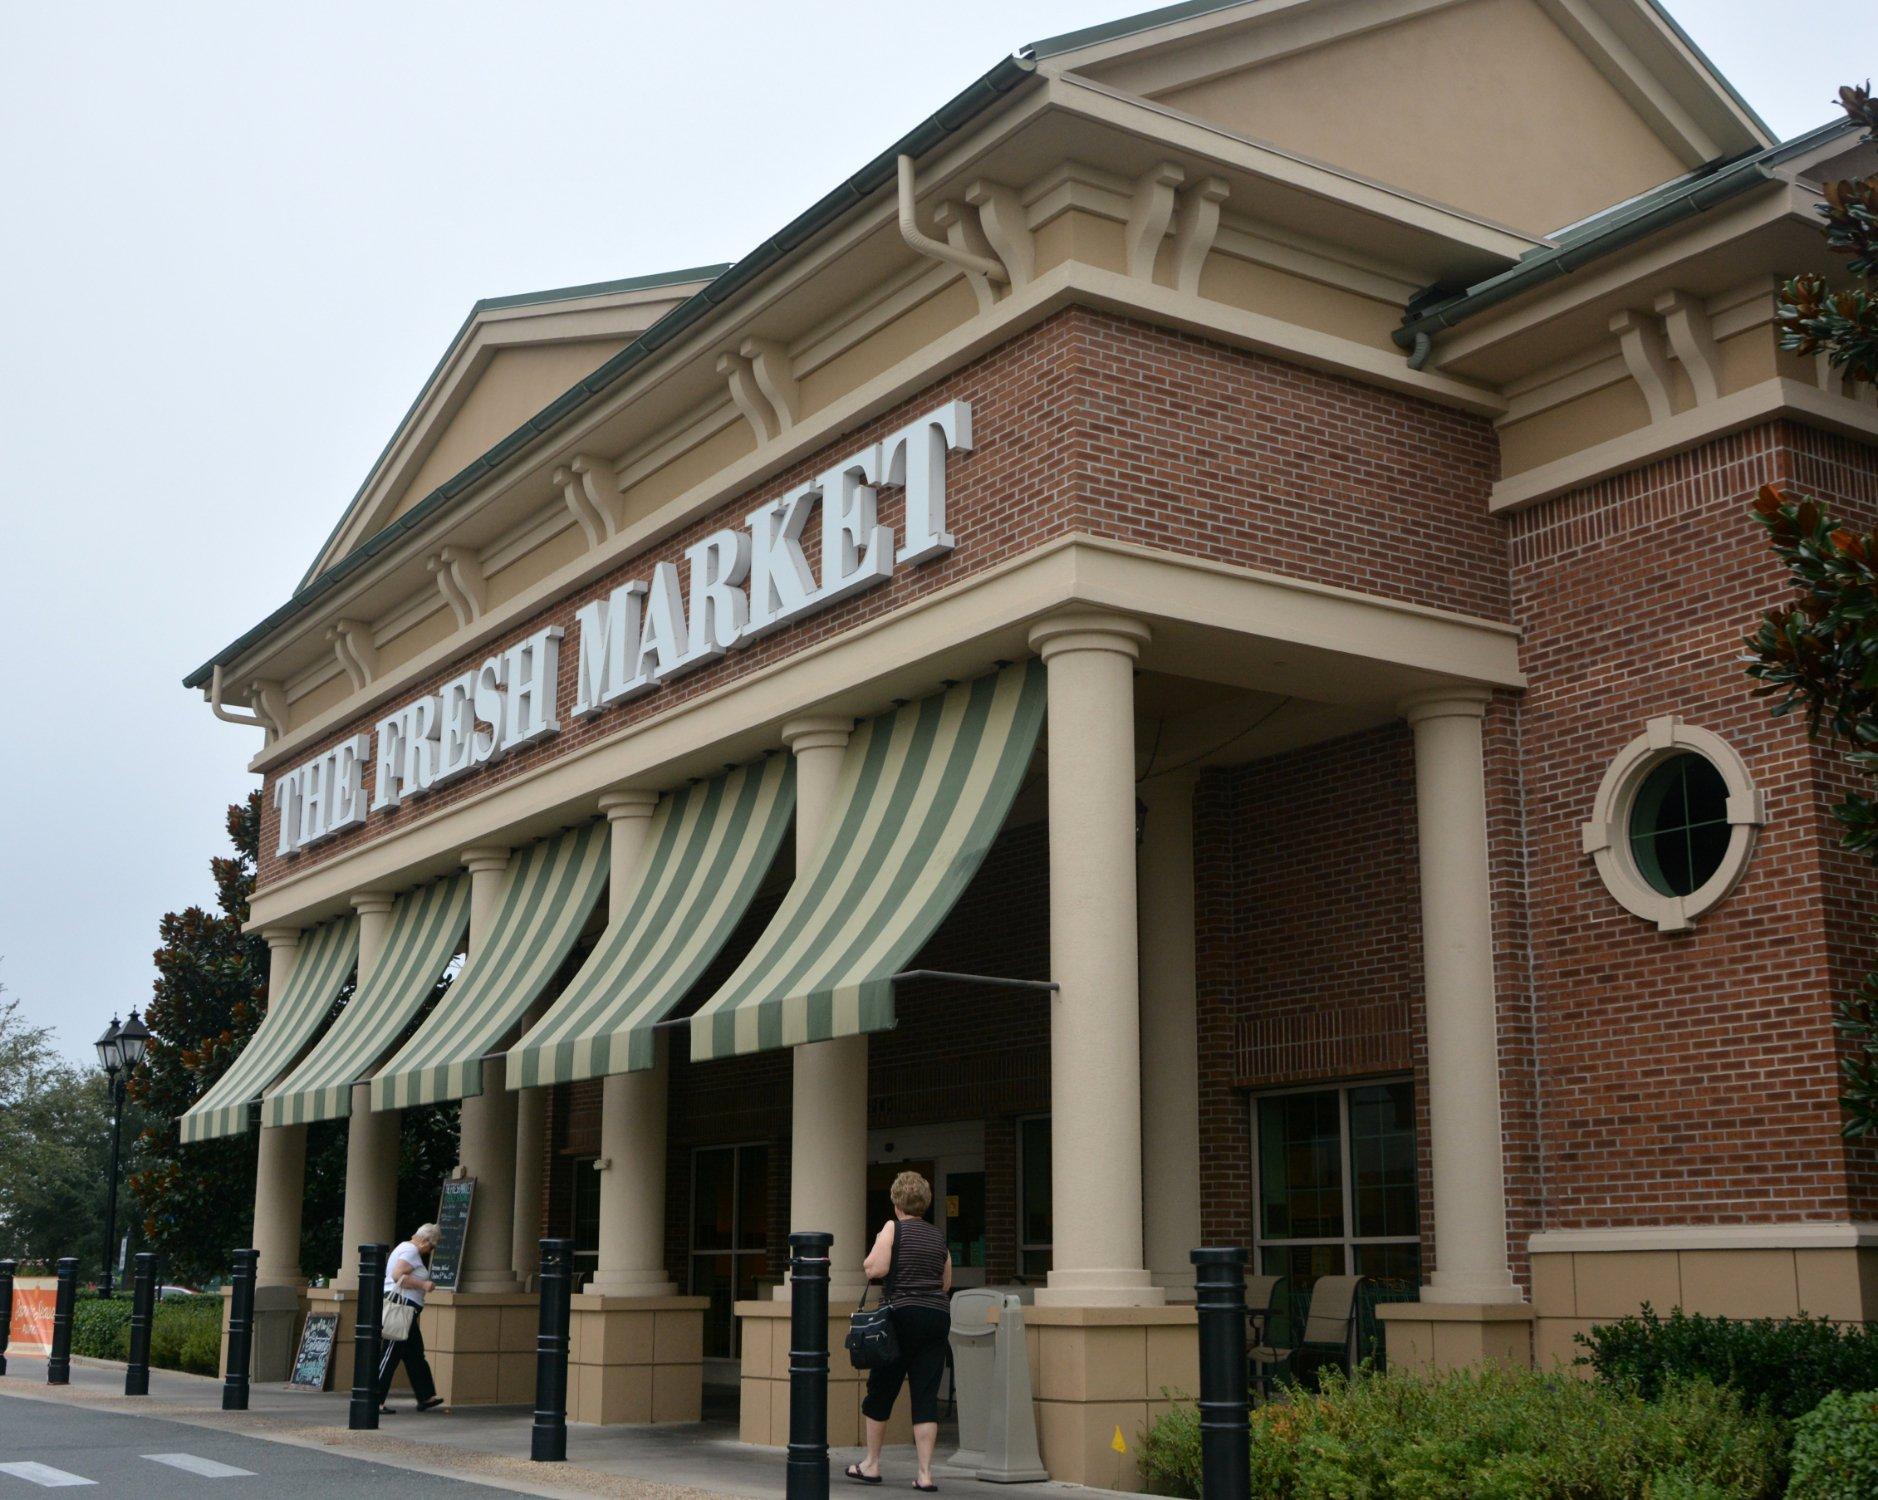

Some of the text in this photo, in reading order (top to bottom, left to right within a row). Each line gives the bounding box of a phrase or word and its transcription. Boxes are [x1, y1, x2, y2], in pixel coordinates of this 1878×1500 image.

[274, 400, 972, 857] THE FRESH MARKET
